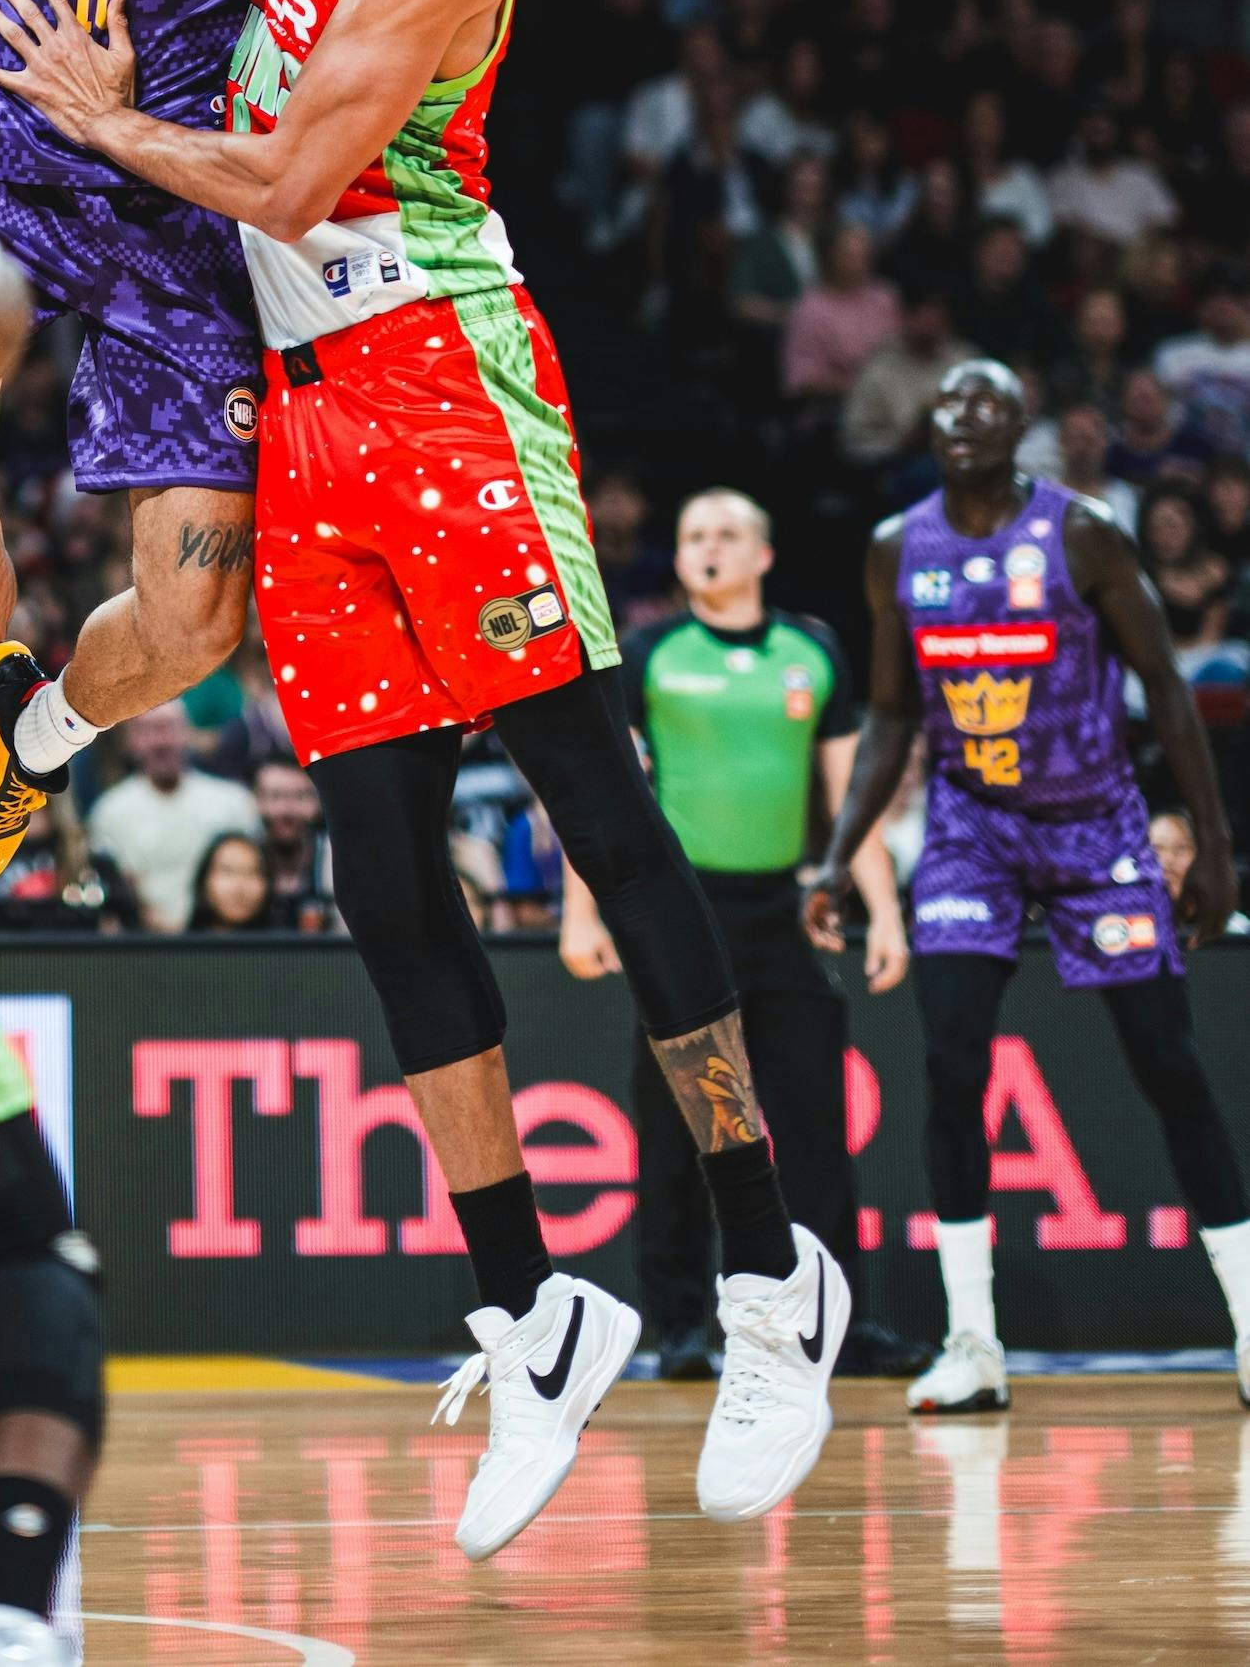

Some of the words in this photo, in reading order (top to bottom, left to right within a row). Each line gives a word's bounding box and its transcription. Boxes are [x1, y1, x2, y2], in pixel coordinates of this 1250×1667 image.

[233, 400, 254, 427] NBL
[488, 611, 521, 638] NBL
[963, 737, 1022, 786] 42
[132, 1039, 639, 1257] The
